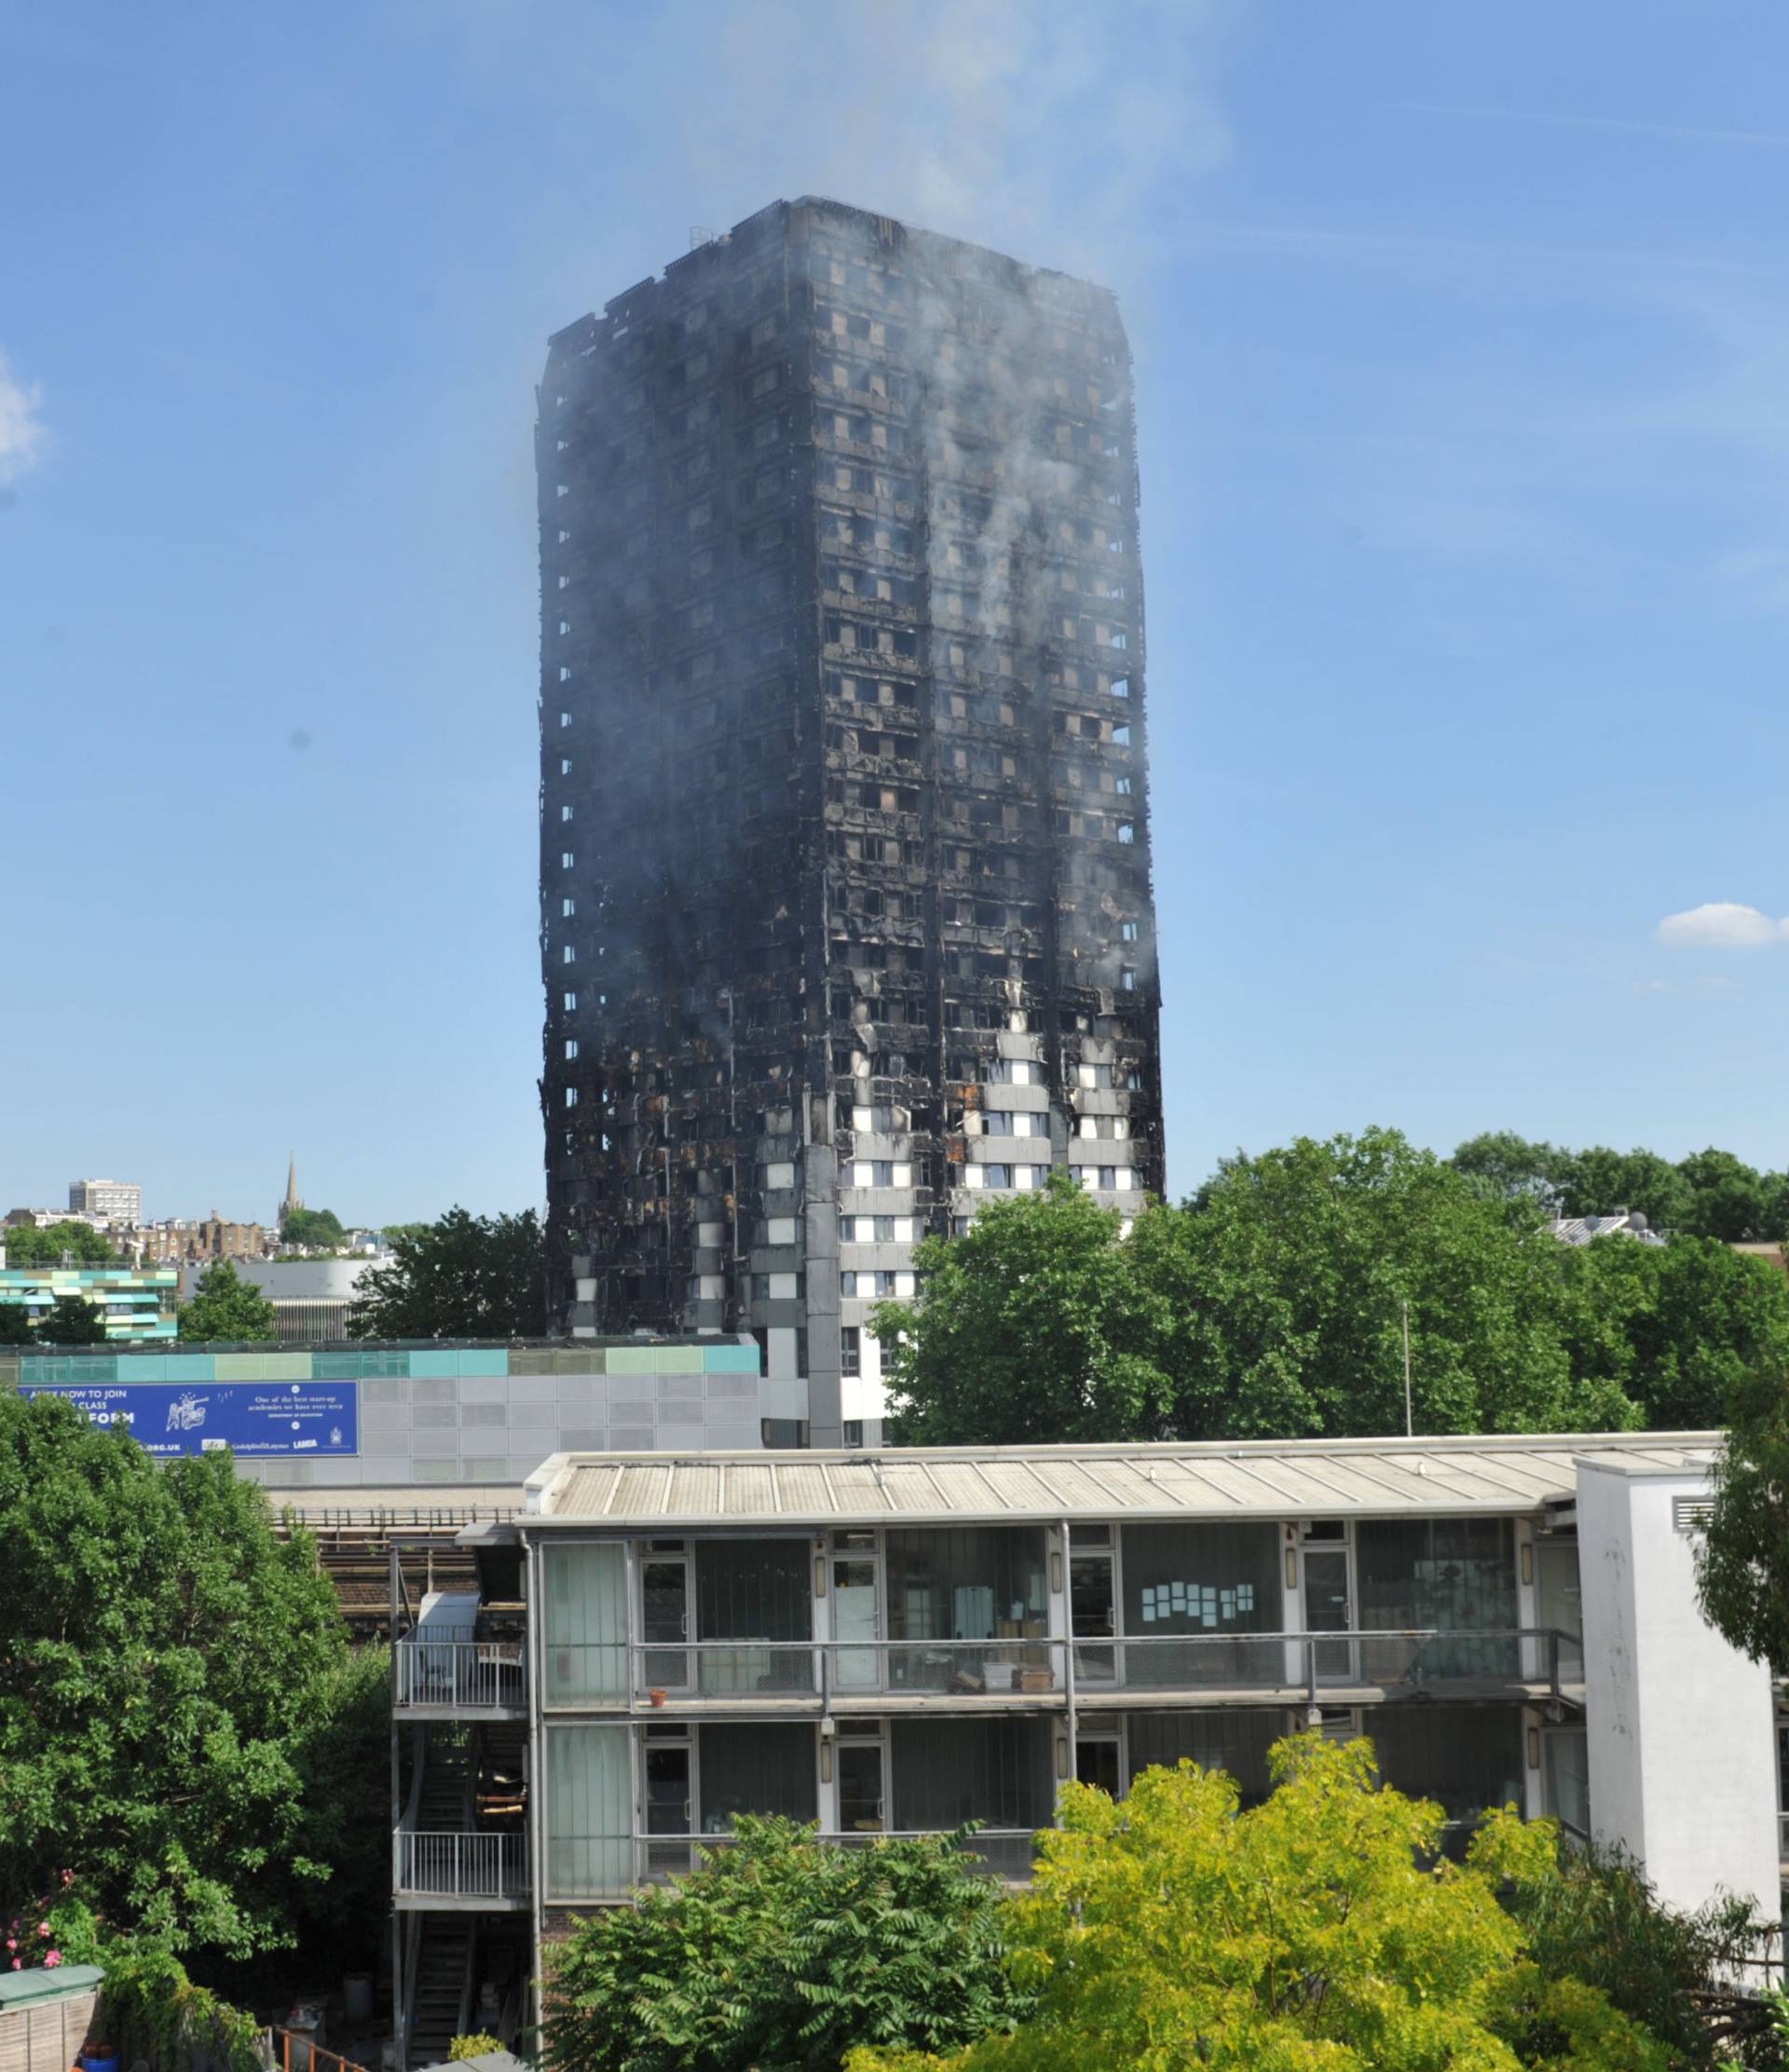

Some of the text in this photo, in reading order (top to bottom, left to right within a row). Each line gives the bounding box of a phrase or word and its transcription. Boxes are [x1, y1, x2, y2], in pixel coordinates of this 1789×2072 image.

[61, 1390, 86, 1398] NOW
[89, 1390, 102, 1398] TO
[104, 1390, 127, 1399] JOIN
[78, 1401, 107, 1410] CLASS
[89, 1412, 135, 1424] FORM
